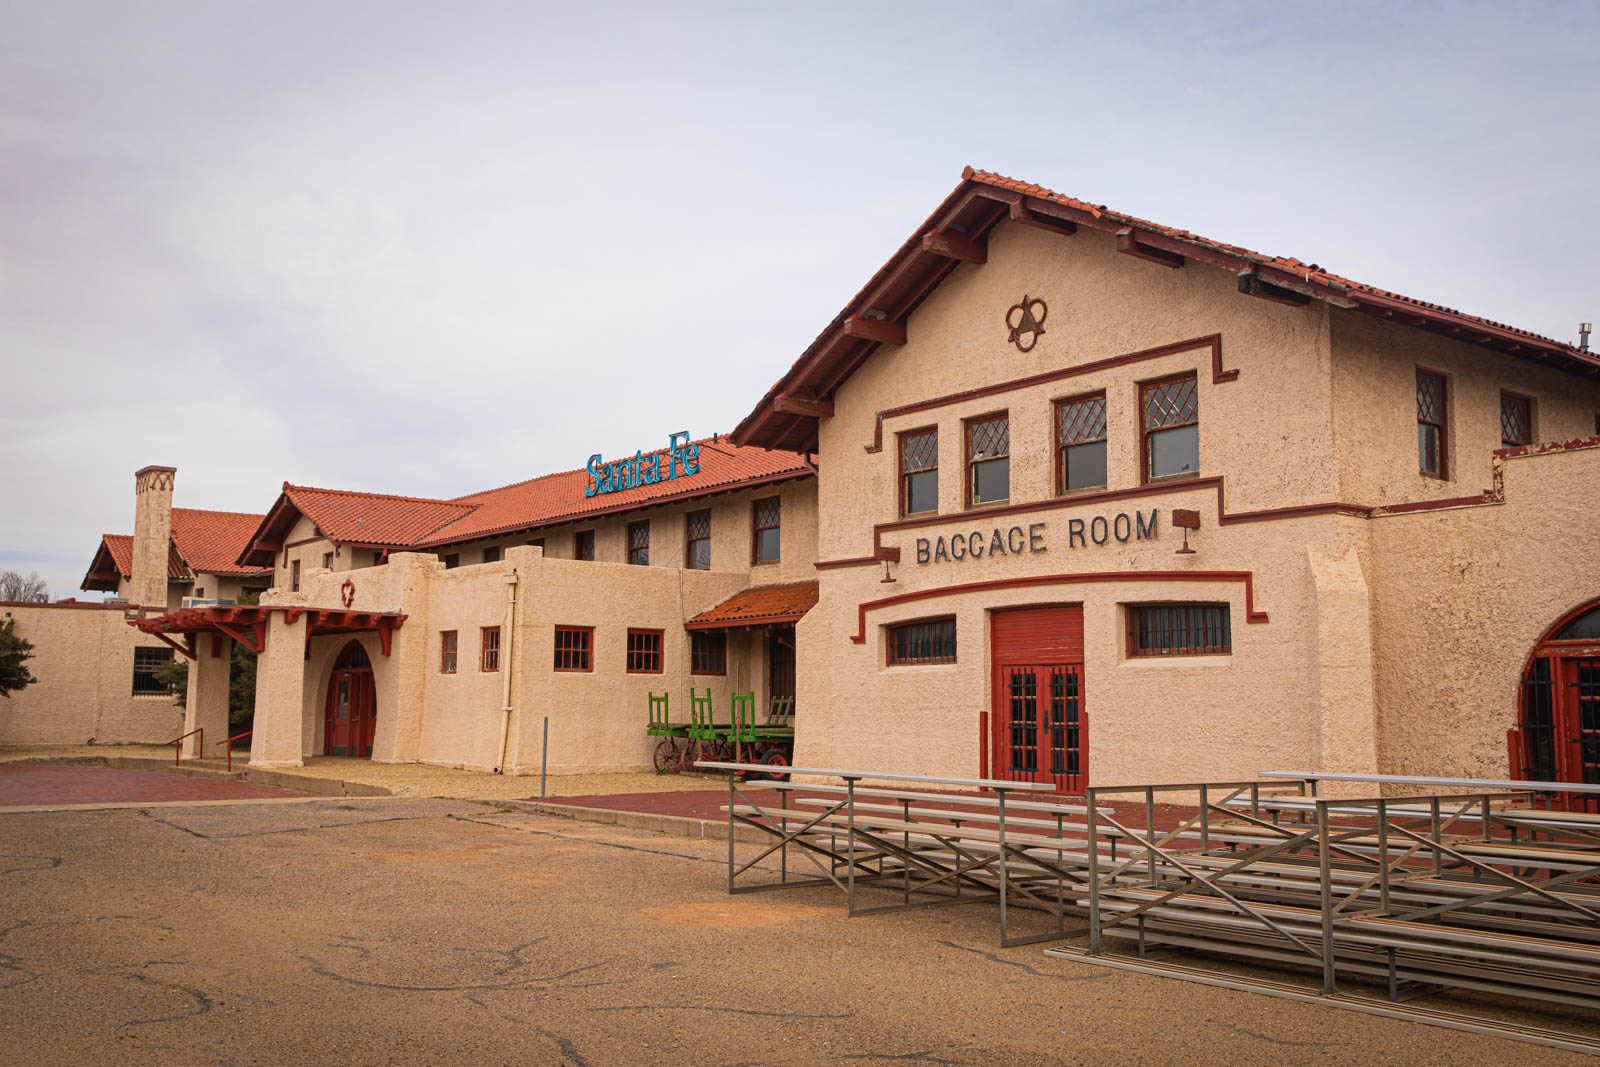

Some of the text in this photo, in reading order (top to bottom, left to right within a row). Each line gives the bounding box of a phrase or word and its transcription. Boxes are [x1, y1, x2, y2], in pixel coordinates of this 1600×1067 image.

[584, 430, 700, 498] Santa Fe
[916, 508, 1159, 564] BAGGAGE ROOM
